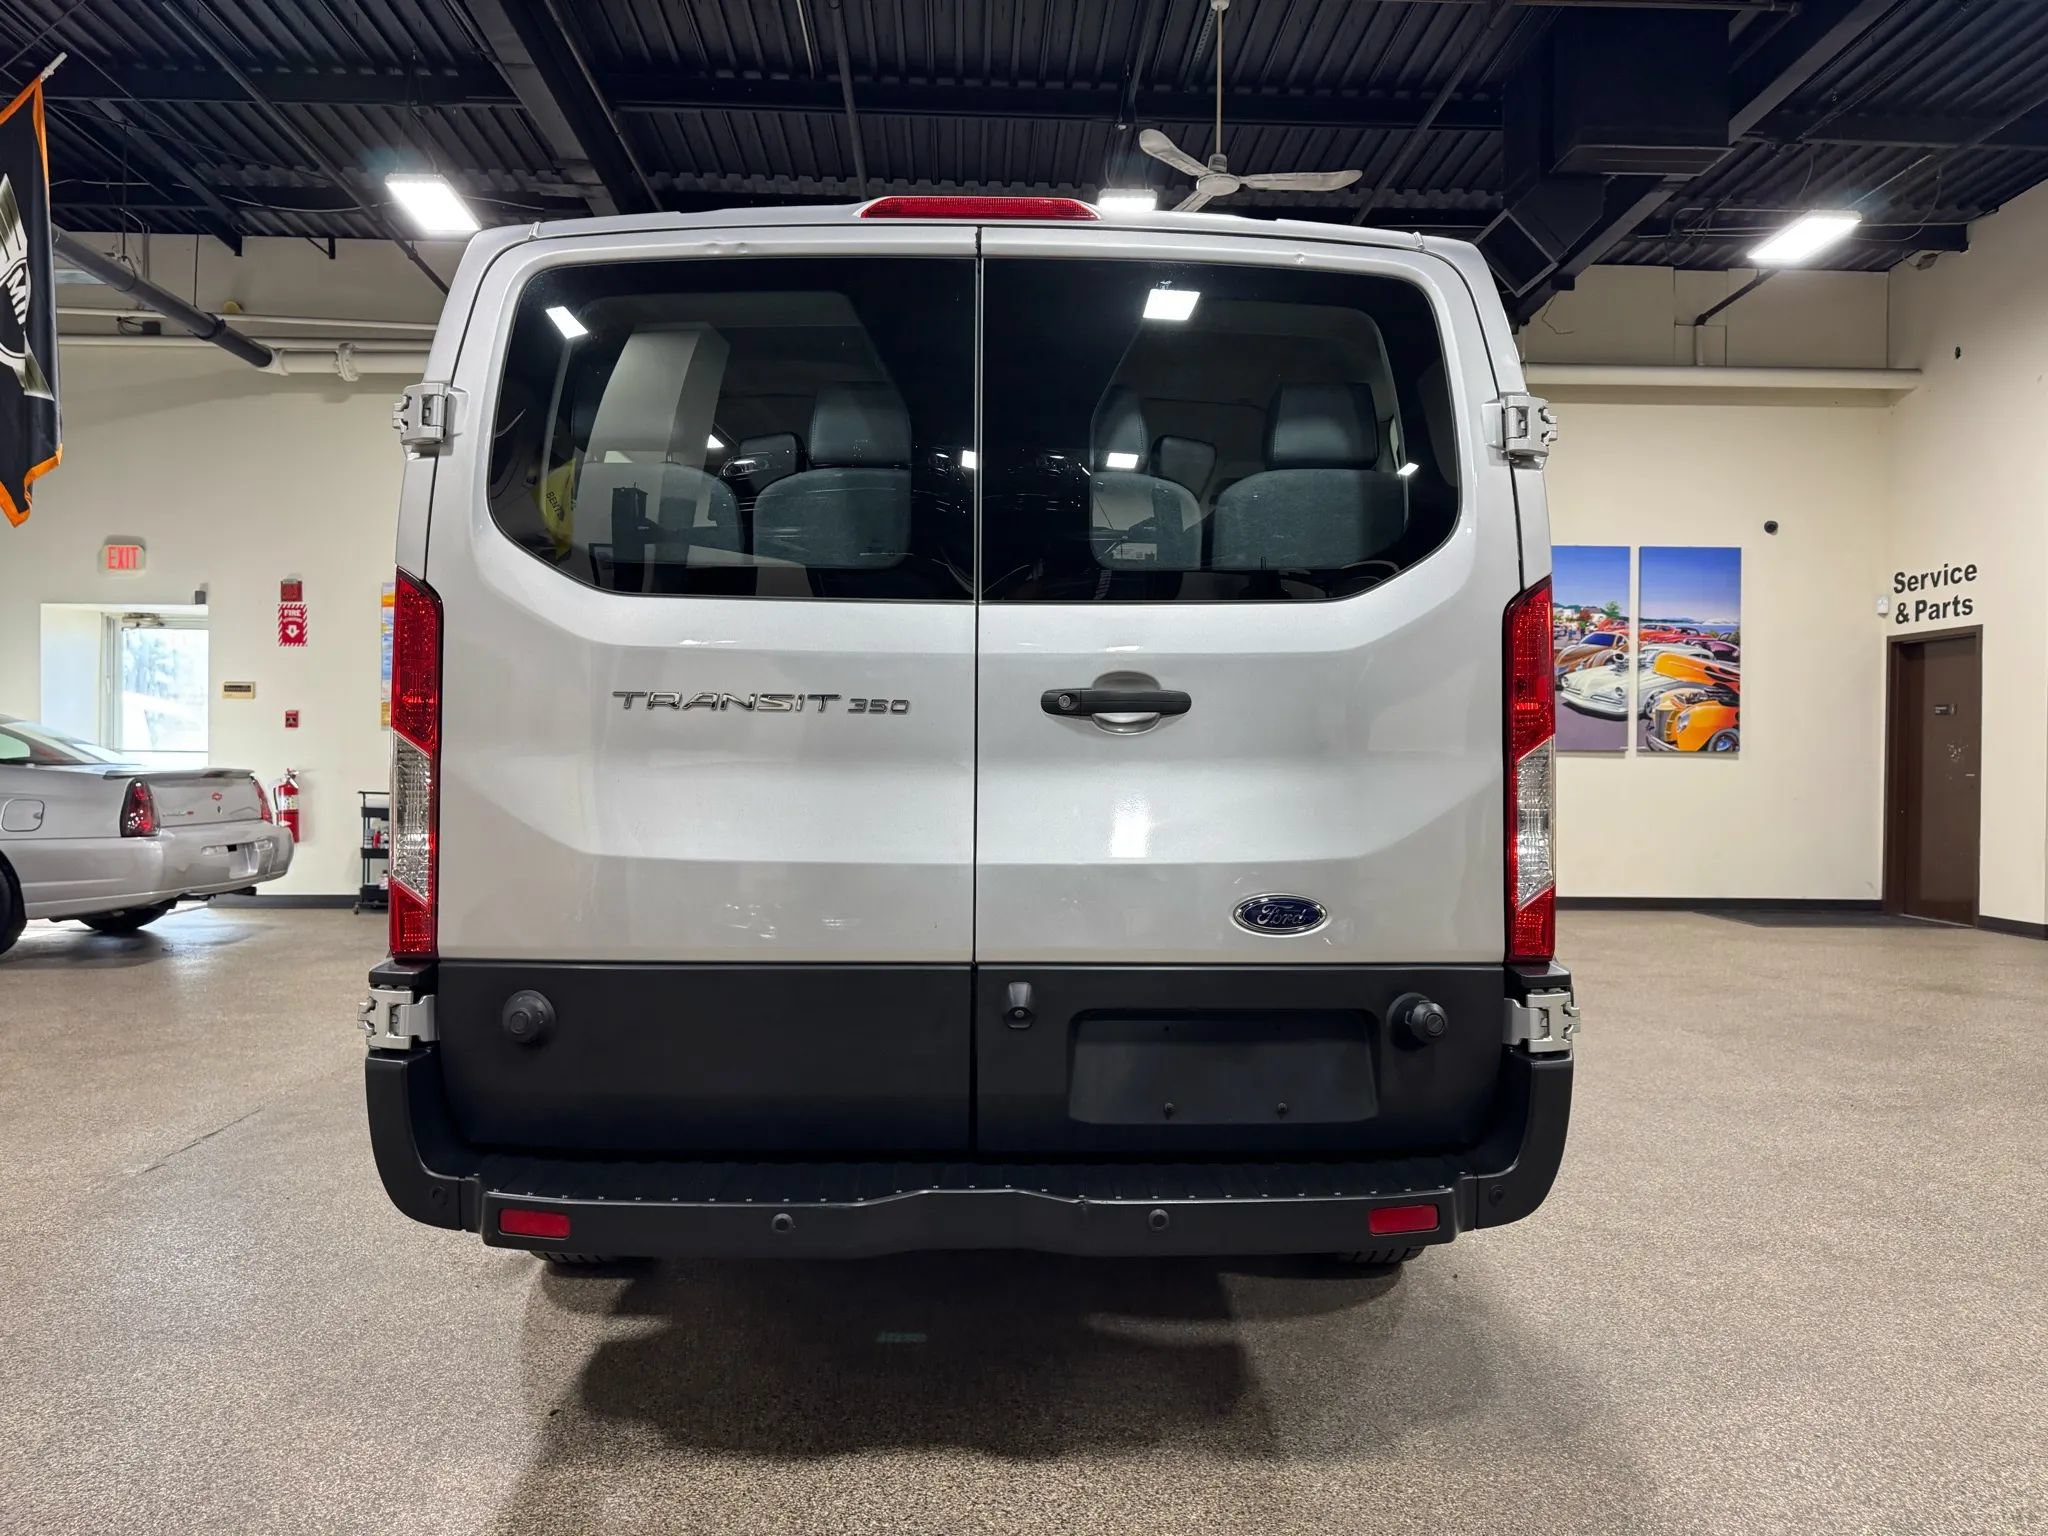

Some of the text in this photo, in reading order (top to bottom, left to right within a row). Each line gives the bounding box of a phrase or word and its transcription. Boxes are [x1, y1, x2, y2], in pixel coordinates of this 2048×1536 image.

[108, 546, 138, 569] EXIT
[1893, 563, 1978, 594] Service
[284, 609, 302, 617] FIRE
[1895, 594, 1974, 624] & Parts
[613, 691, 911, 714] TRANSIT 350
[1257, 903, 1307, 925] Ford
